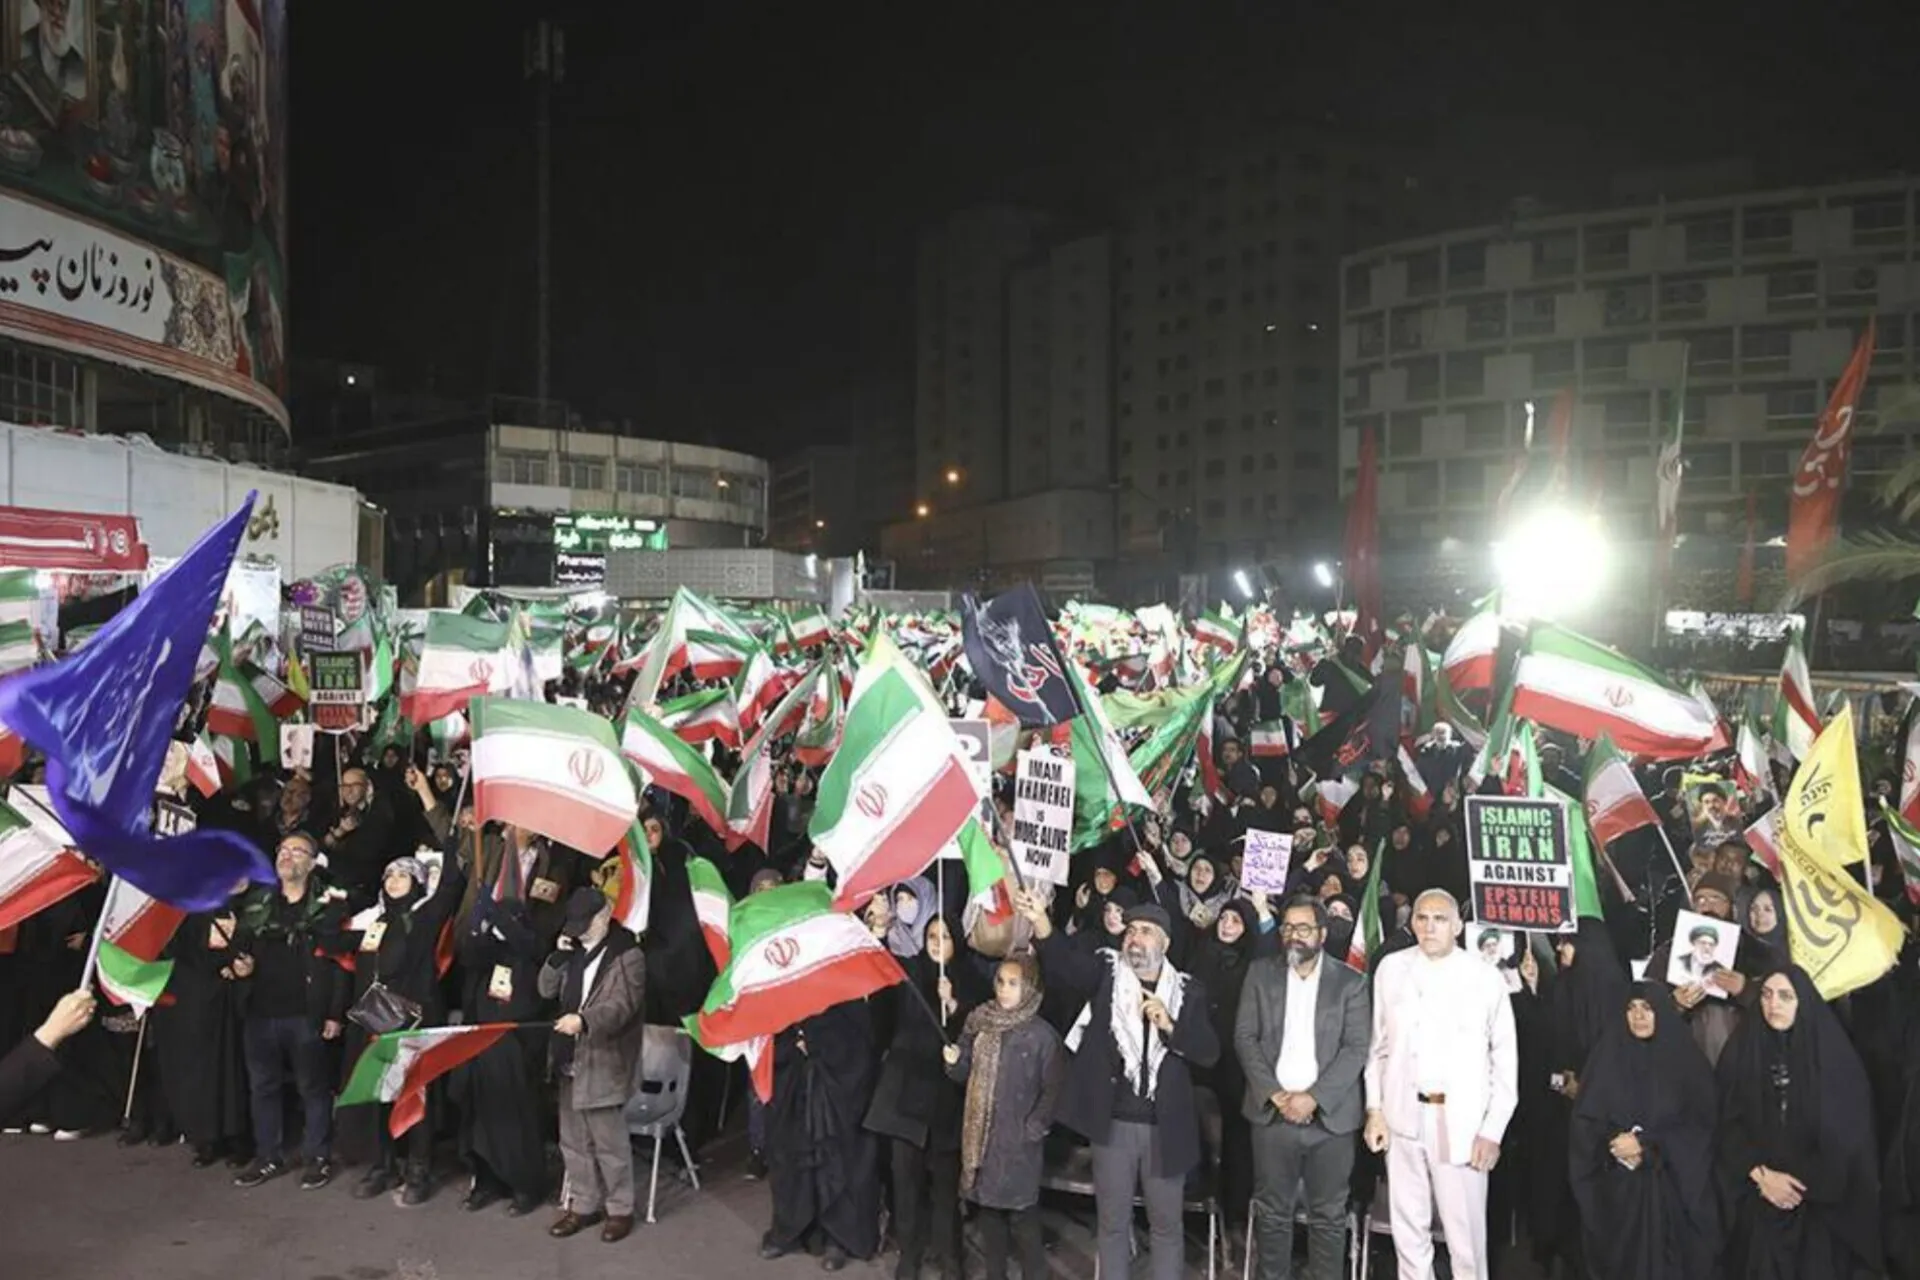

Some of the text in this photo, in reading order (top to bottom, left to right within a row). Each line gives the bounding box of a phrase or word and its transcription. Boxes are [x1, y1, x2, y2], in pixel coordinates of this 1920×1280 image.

[317, 673, 355, 688] IRAN
[316, 691, 356, 701] AGAINST
[1029, 760, 1061, 781] IMAM
[1018, 779, 1070, 808] KHAMENEI
[1481, 807, 1552, 826] ISLAMIC
[1014, 820, 1067, 852] MORE ALIVE
[1481, 825, 1552, 837] REPUBLIC OF
[1481, 834, 1555, 861] IRAN
[1026, 848, 1051, 867] NOW
[1484, 863, 1557, 882] AGAINST
[1485, 887, 1560, 906] EPSTEIN
[1486, 904, 1561, 924] DEMONS
